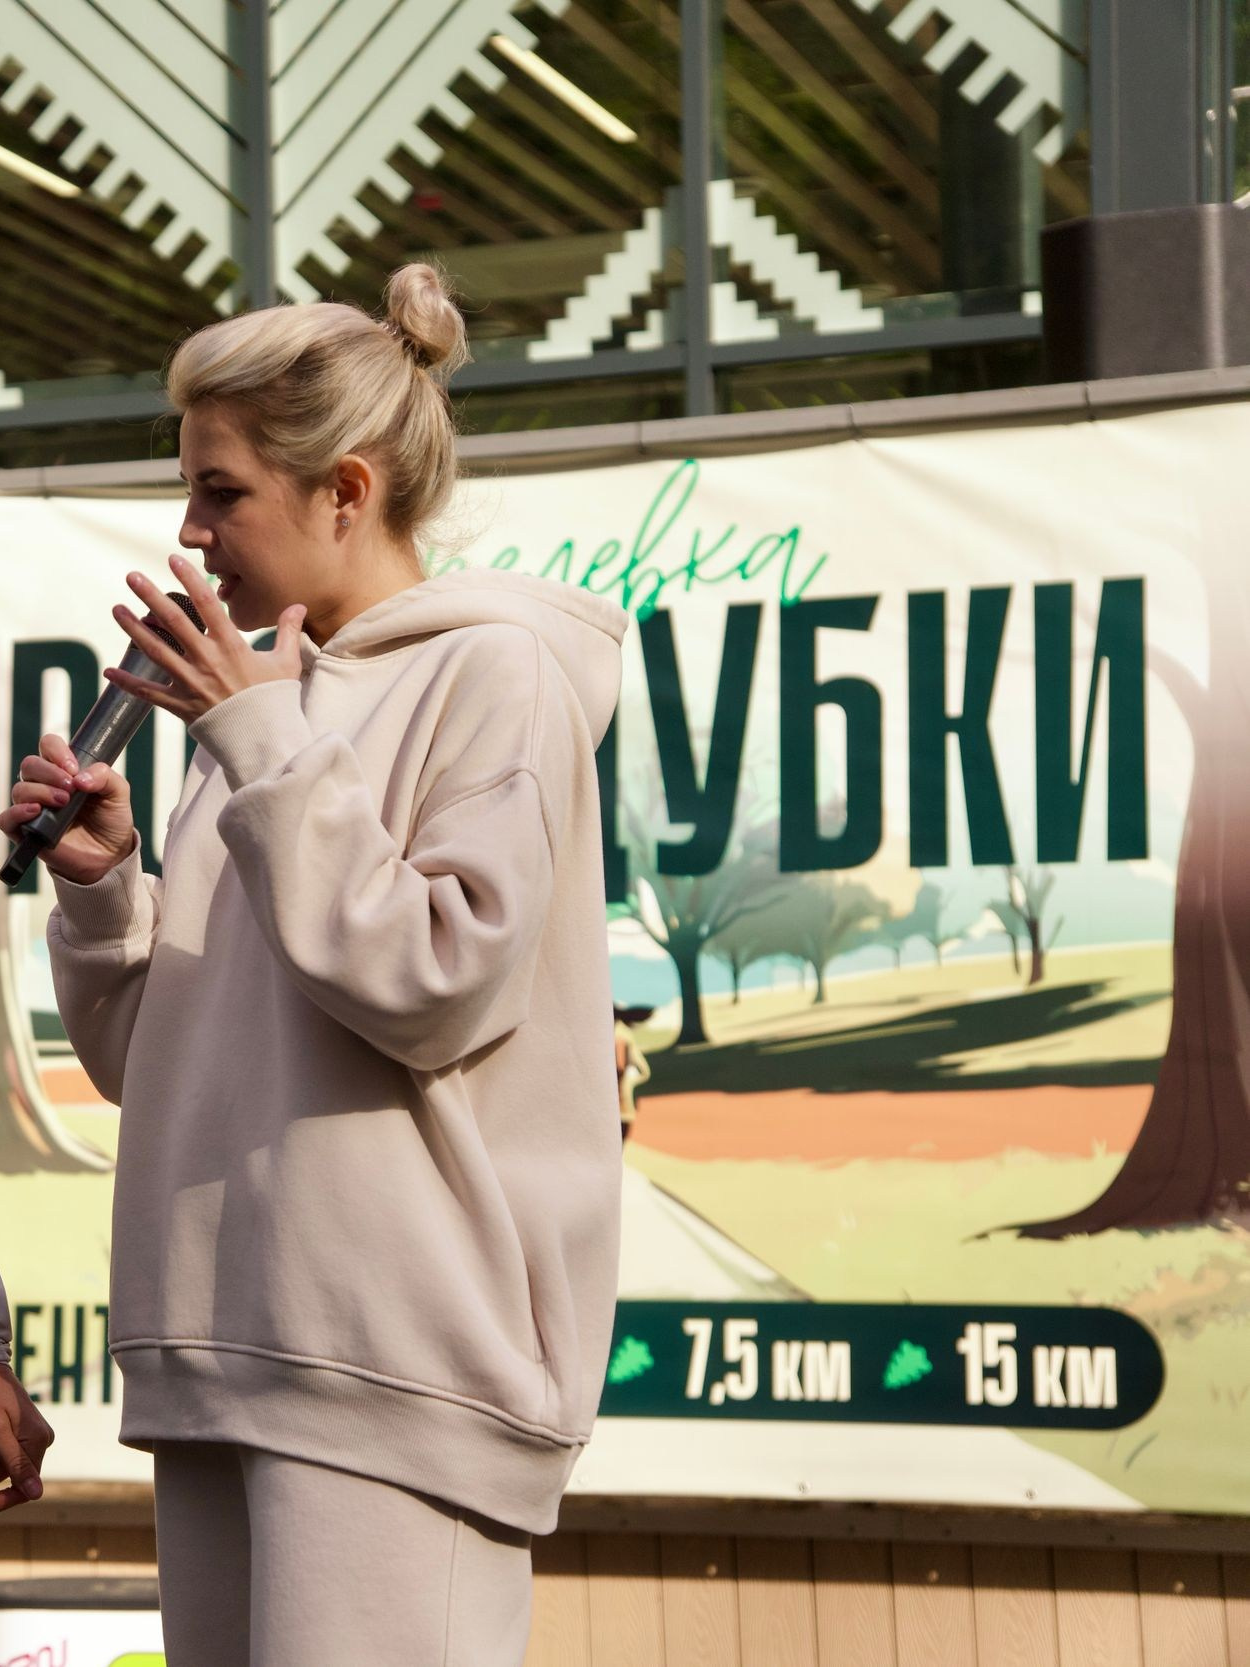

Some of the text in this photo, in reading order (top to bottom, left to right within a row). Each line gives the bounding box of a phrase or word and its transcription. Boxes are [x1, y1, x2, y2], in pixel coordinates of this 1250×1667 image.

[422, 458, 828, 621] елевка
[681, 1317, 759, 1406] 7,5
[955, 1321, 1019, 1407] 15
